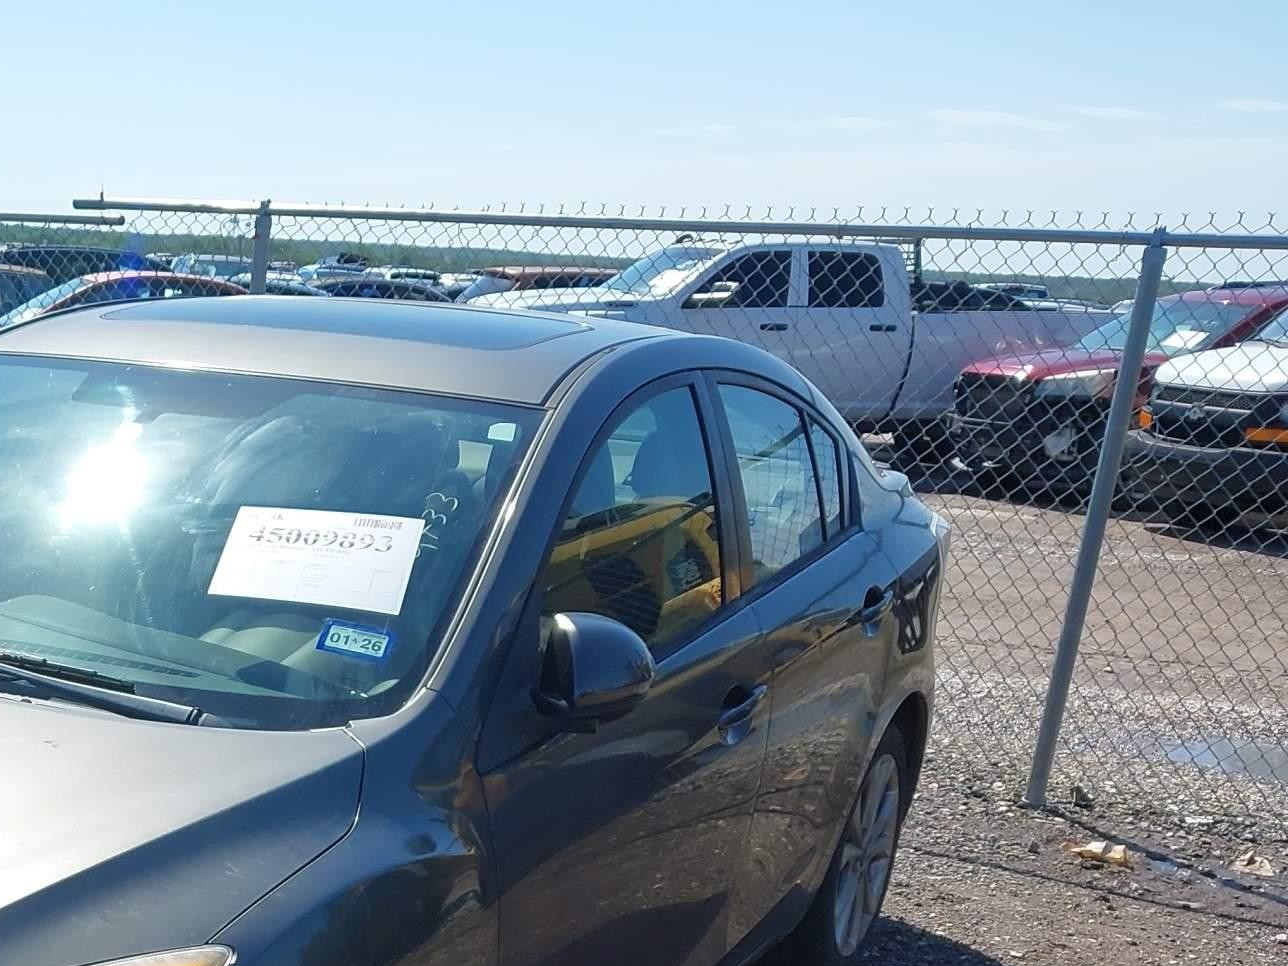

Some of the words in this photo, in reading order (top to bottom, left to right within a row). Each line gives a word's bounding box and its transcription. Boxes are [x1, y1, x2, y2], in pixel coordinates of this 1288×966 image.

[249, 526, 393, 553] 45009893
[329, 632, 351, 646] 01
[359, 638, 384, 652] 26
